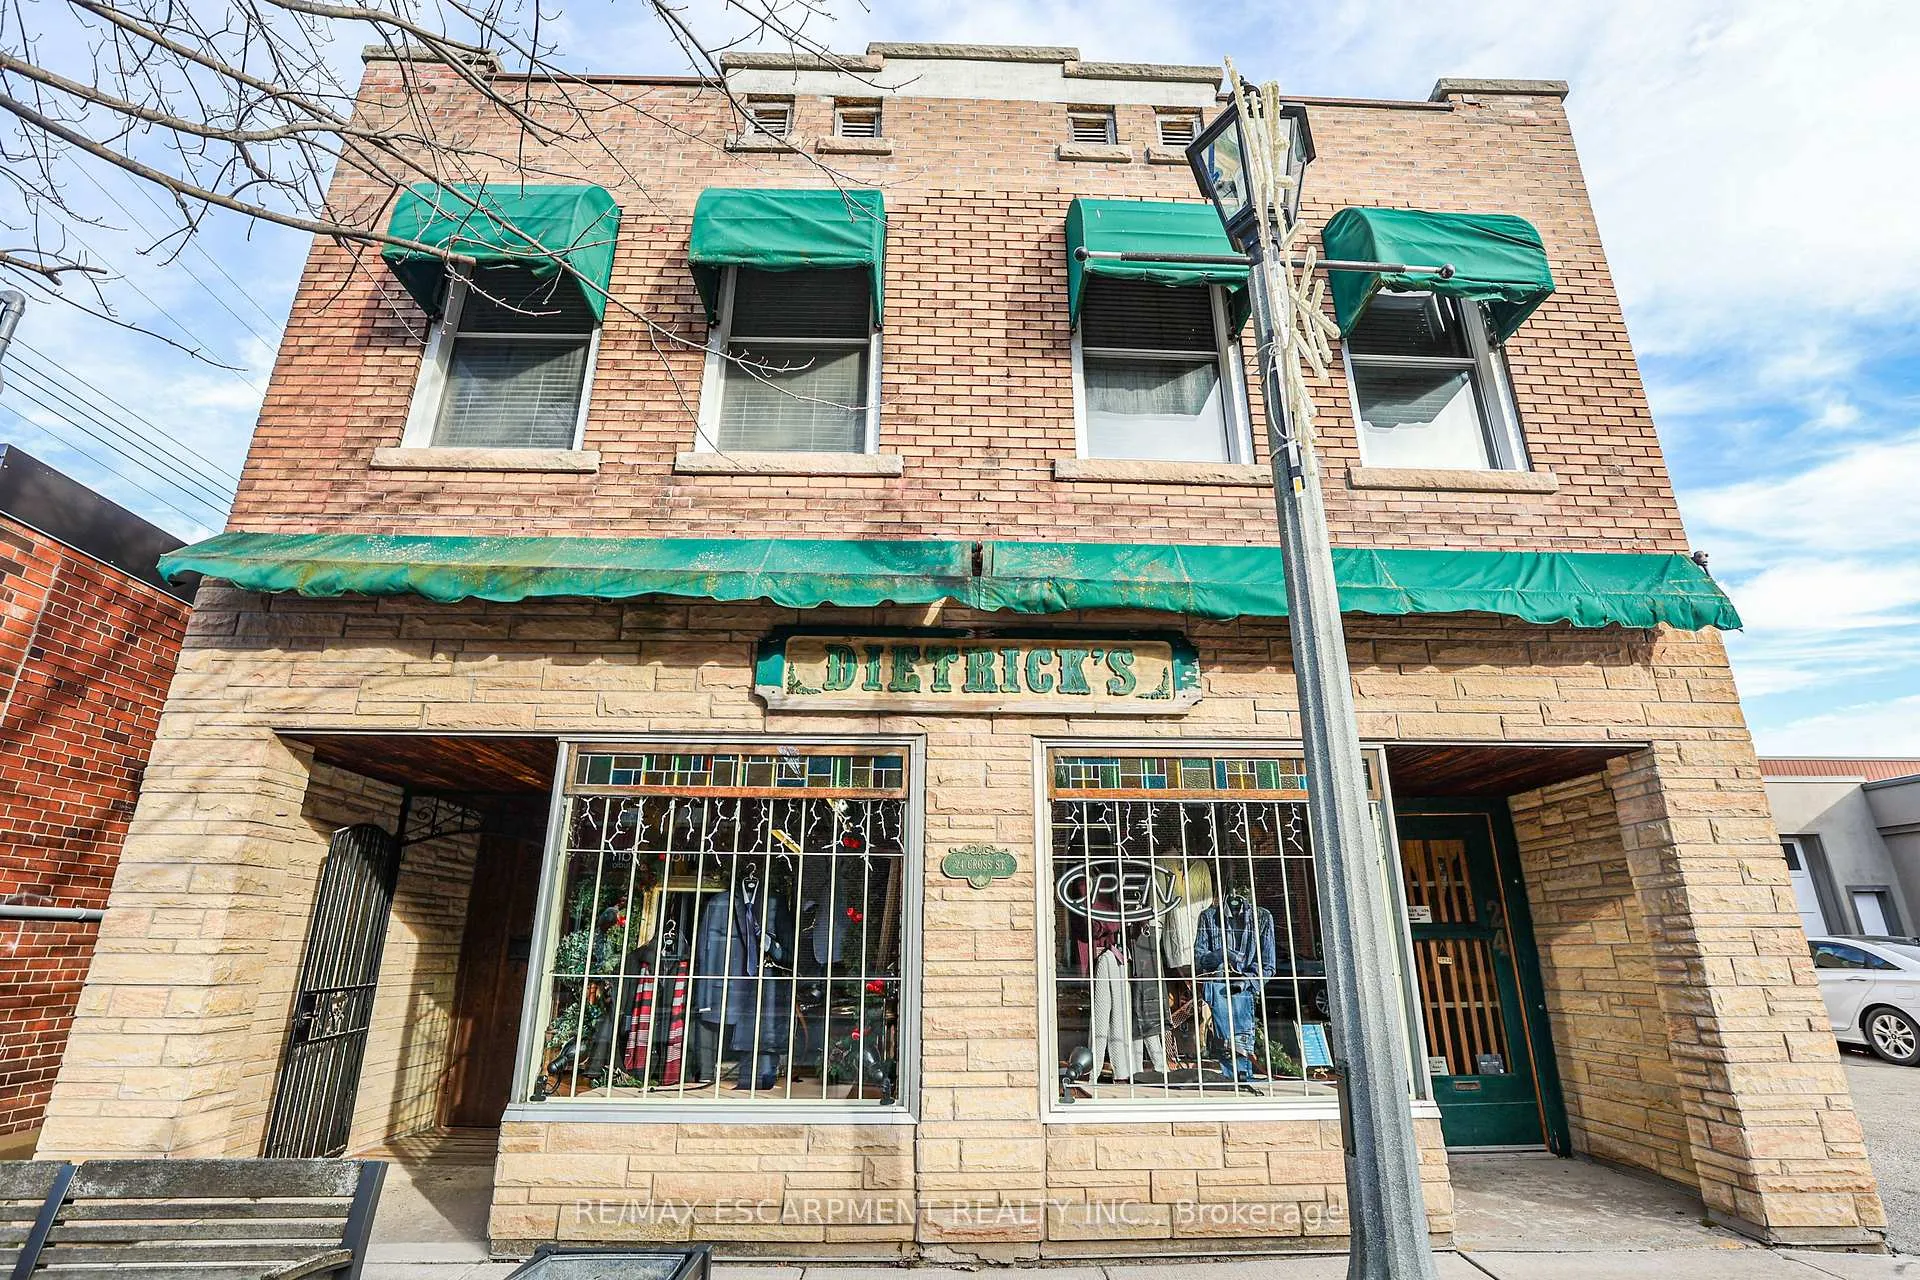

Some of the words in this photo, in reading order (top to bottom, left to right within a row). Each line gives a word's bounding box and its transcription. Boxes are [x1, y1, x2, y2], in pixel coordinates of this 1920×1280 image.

[822, 643, 1137, 696] DIETRICK'S
[967, 860, 993, 870] CROSS
[1064, 873, 1176, 904] OPEN
